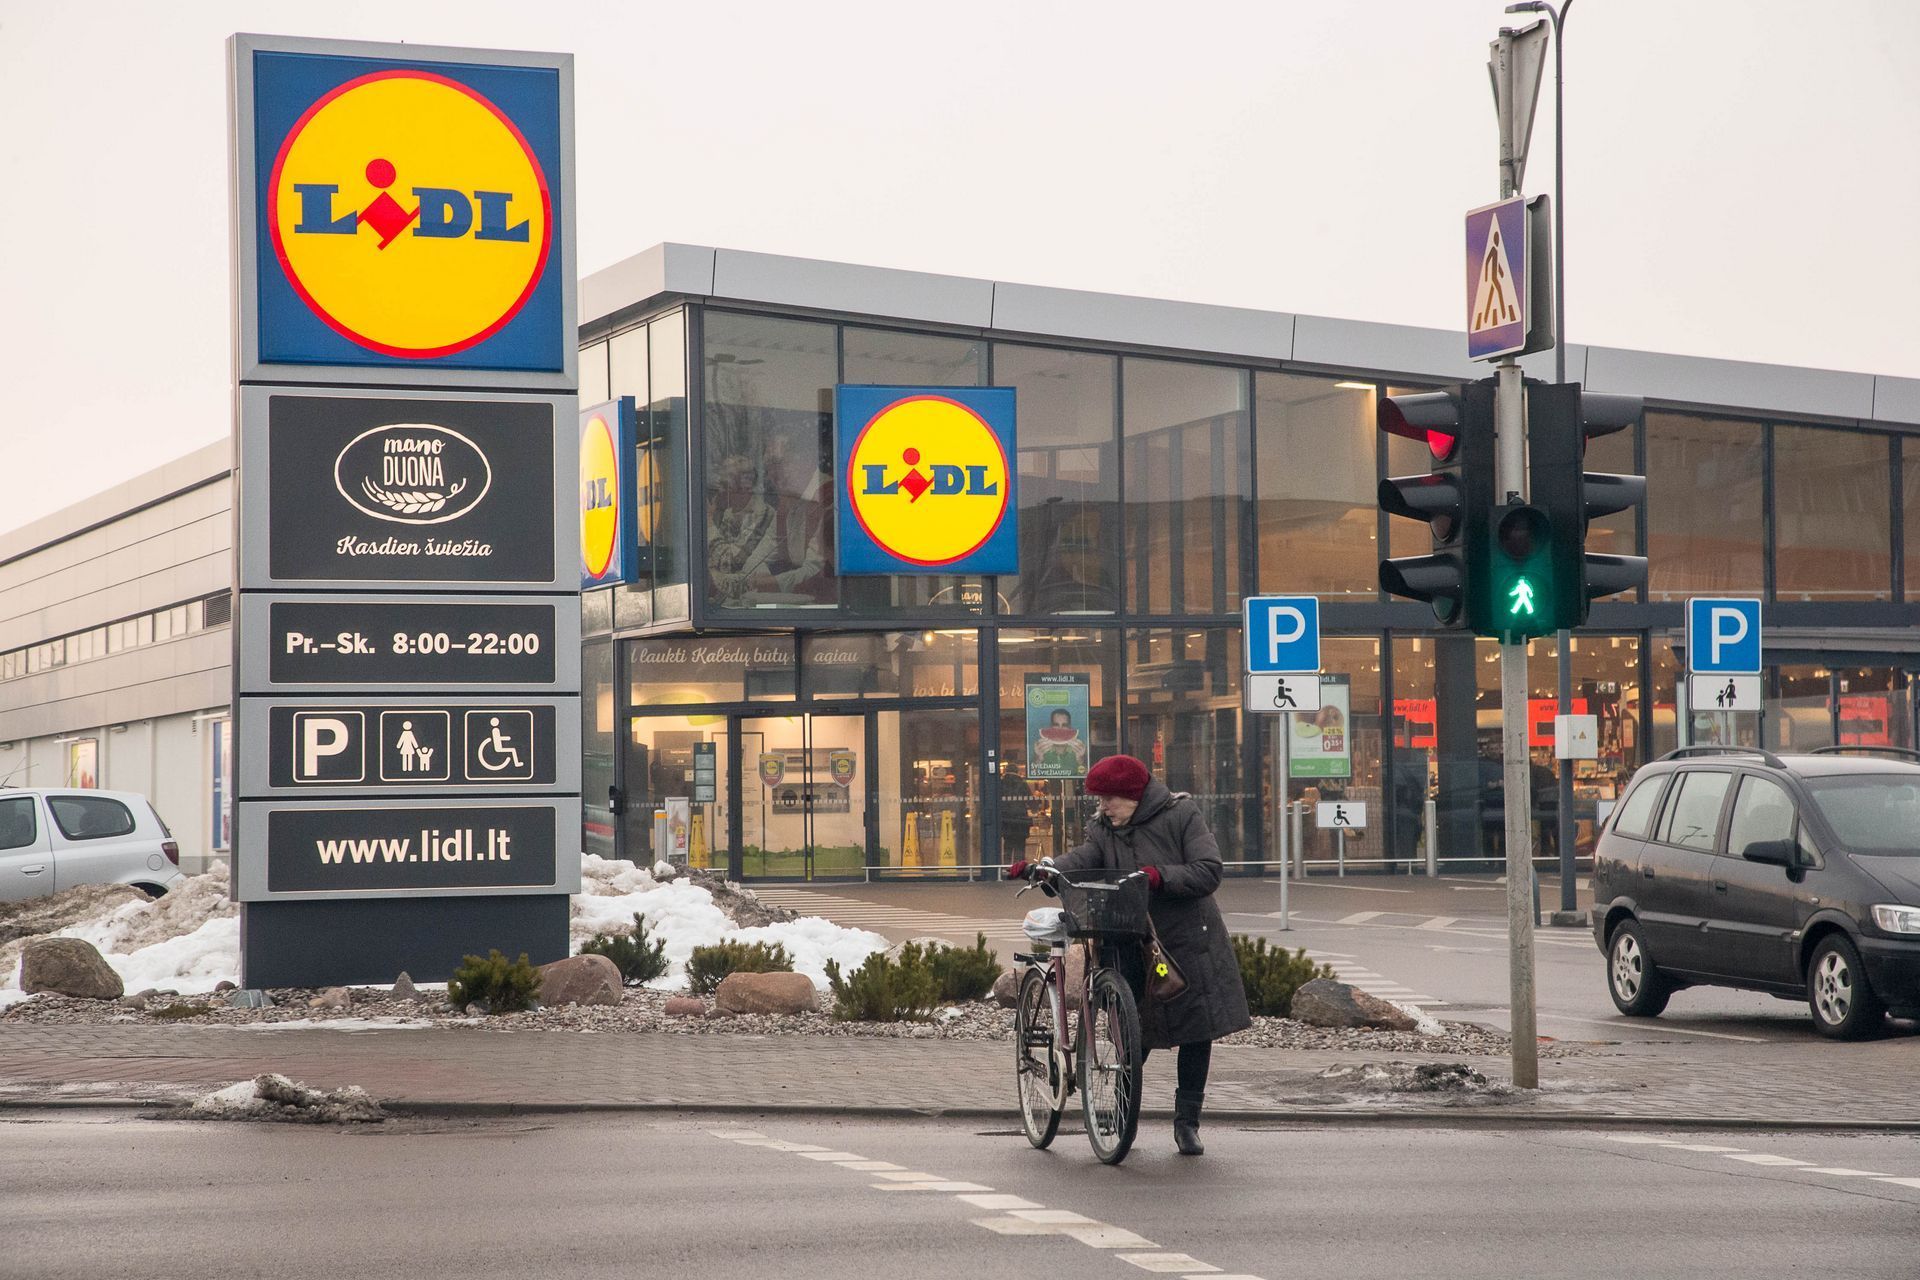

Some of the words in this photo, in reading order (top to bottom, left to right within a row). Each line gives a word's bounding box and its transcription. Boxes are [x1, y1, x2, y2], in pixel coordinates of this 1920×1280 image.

[384, 438, 447, 455] mano
[383, 456, 445, 486] DUONA
[586, 477, 612, 511] DL
[336, 535, 422, 556] Kasdien
[424, 537, 493, 556] šviežia
[1268, 606, 1306, 664] P
[1711, 607, 1748, 664] P
[640, 647, 687, 664] laukti
[1041, 675, 1075, 683] www.lidl.lt
[304, 718, 349, 776] P
[316, 828, 511, 864] www.lidl.lt
